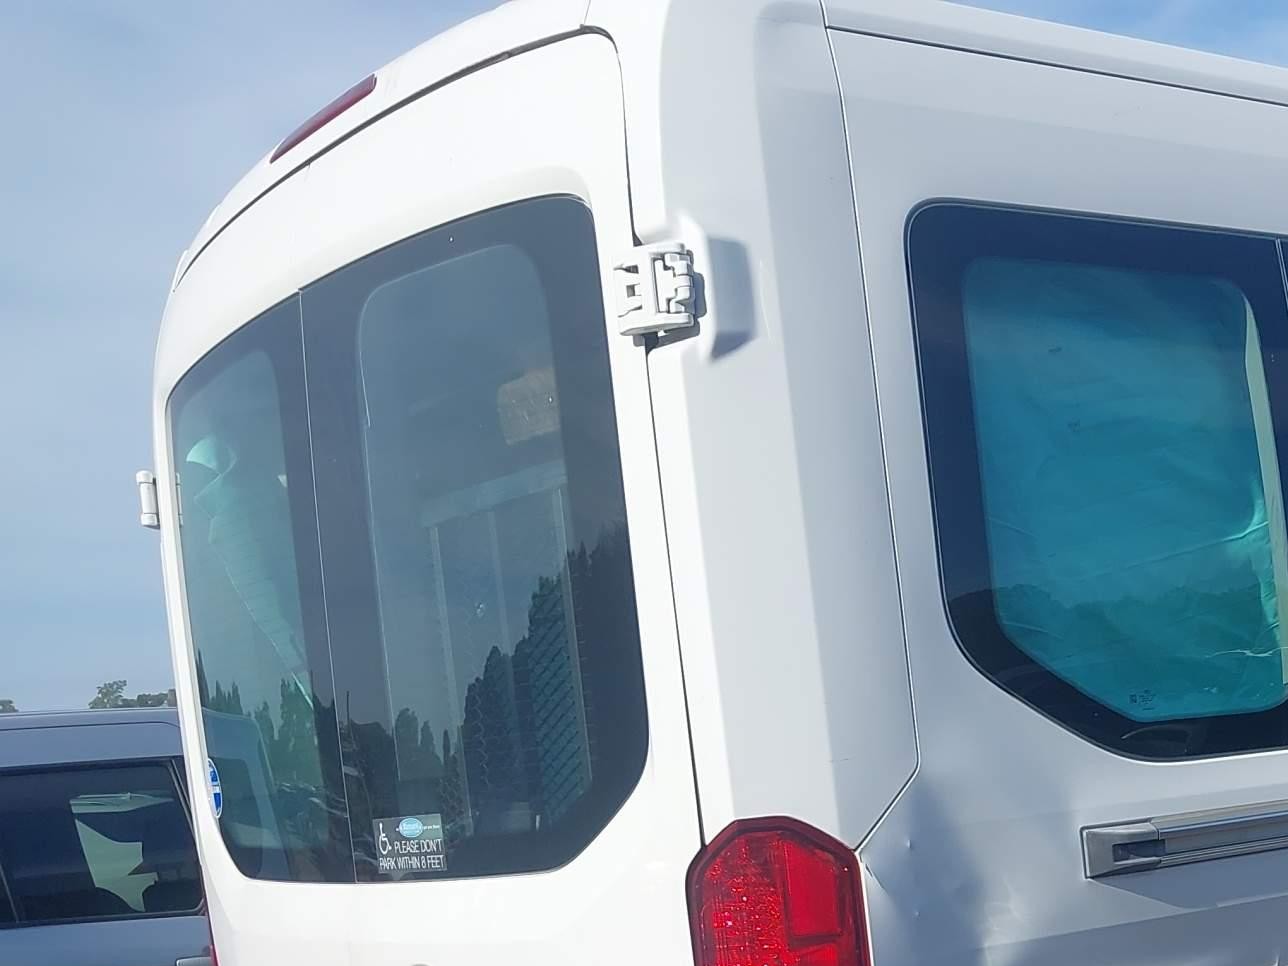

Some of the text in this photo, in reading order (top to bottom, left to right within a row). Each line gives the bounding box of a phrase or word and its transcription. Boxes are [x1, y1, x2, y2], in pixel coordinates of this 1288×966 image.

[393, 838, 443, 854] PLEASE DON'T
[378, 856, 397, 870] PARK
[397, 855, 421, 869] WITHIN
[426, 854, 444, 869] FEET
